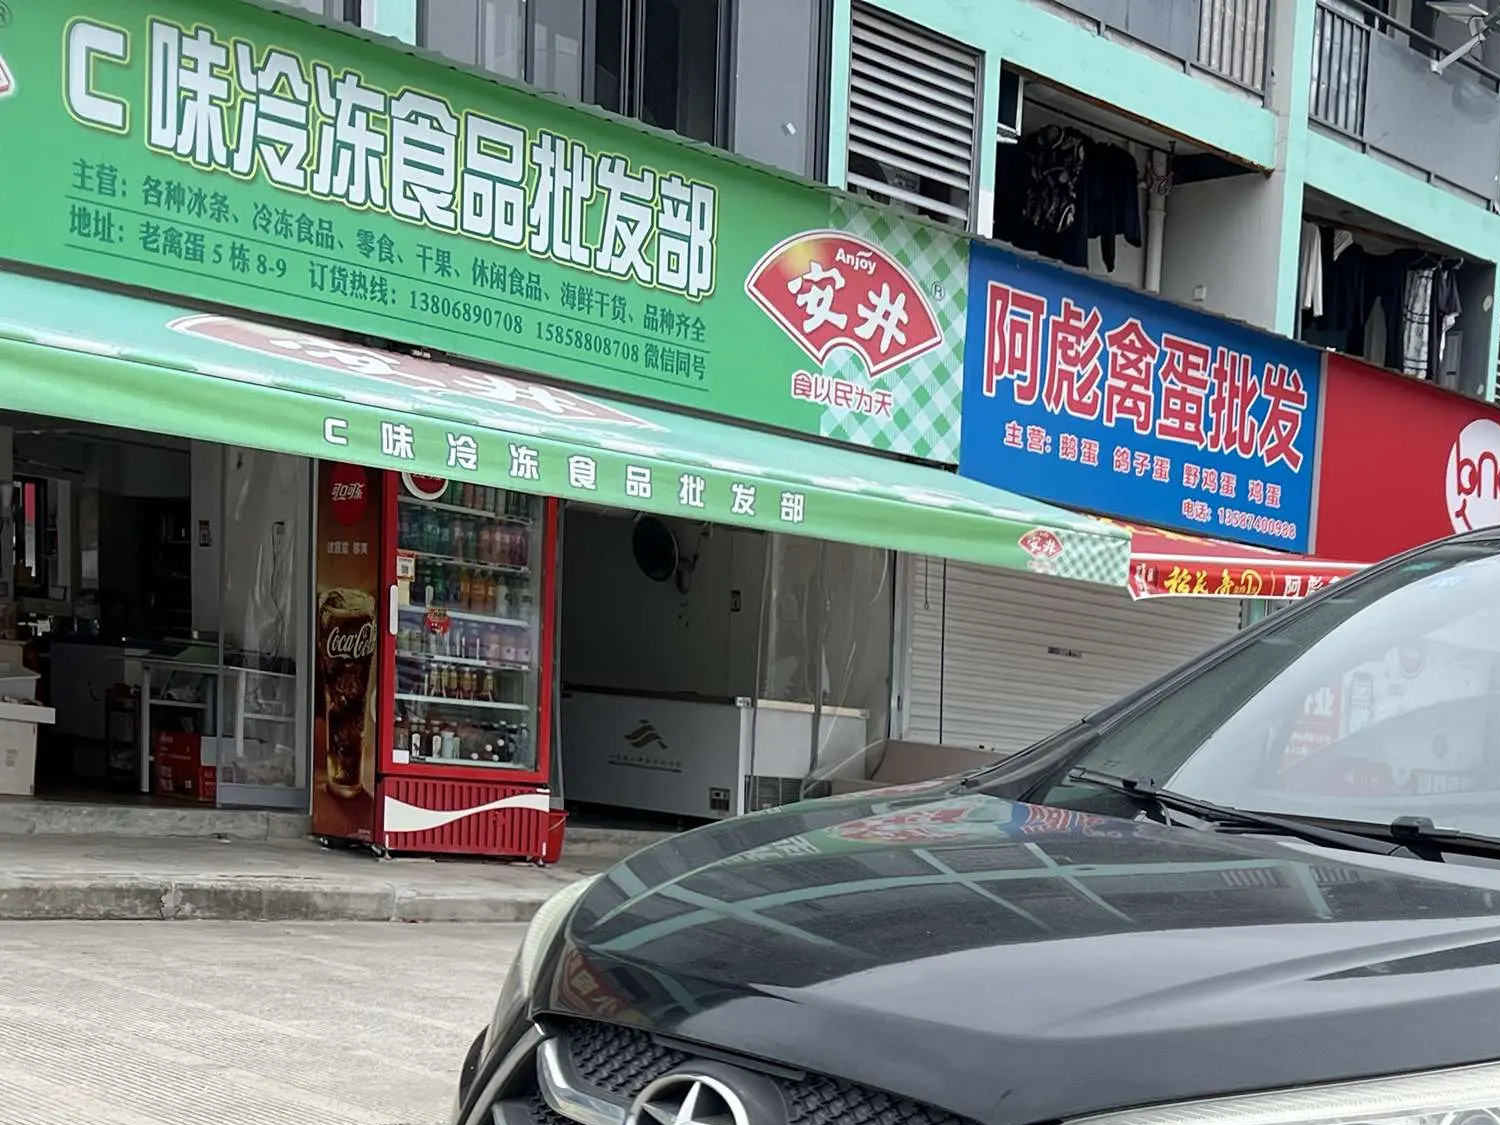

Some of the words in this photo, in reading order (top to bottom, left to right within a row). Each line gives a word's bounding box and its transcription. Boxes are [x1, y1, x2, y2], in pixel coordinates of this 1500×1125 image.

[835, 247, 877, 275] Anjoy
[786, 260, 910, 355] 安井
[791, 369, 894, 419] 食以民为天
[983, 279, 1308, 474] 阿彪禽蛋批发
[331, 482, 366, 501] 可口可乐
[1113, 446, 1171, 483] 鸽子蛋
[1182, 462, 1237, 498] 野鸡蛋
[1248, 478, 1282, 509] 鸡蛋
